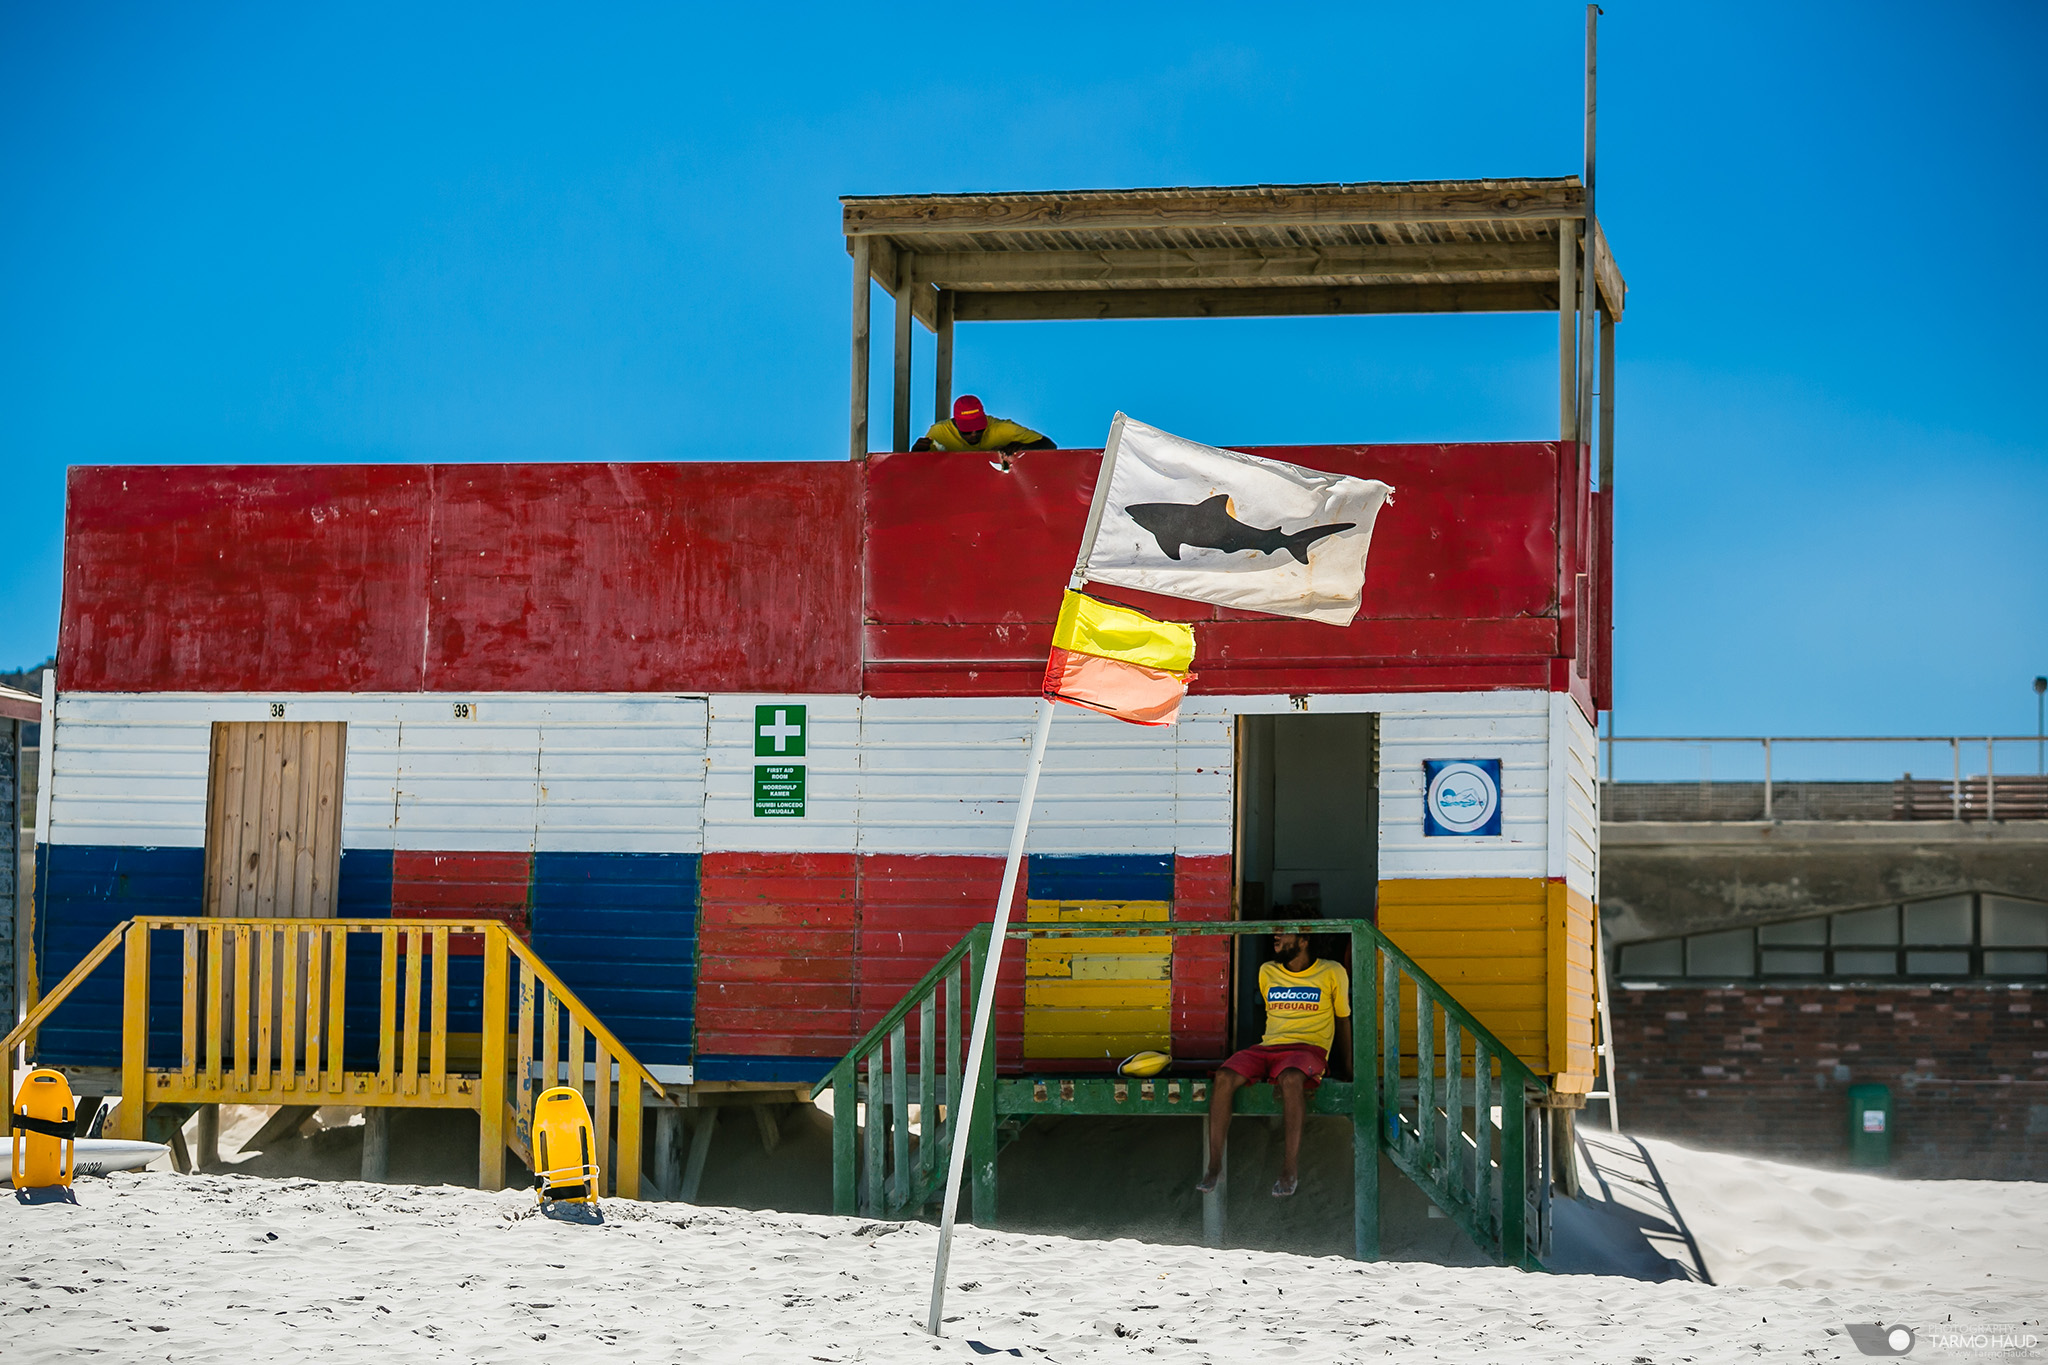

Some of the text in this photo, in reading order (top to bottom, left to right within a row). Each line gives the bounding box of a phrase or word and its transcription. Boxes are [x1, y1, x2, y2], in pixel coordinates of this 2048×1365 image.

[272, 704, 284, 717] 38
[455, 704, 468, 718] 39
[1269, 990, 1319, 1000] vodacom
[1268, 1003, 1319, 1011] LIFEGUARD
